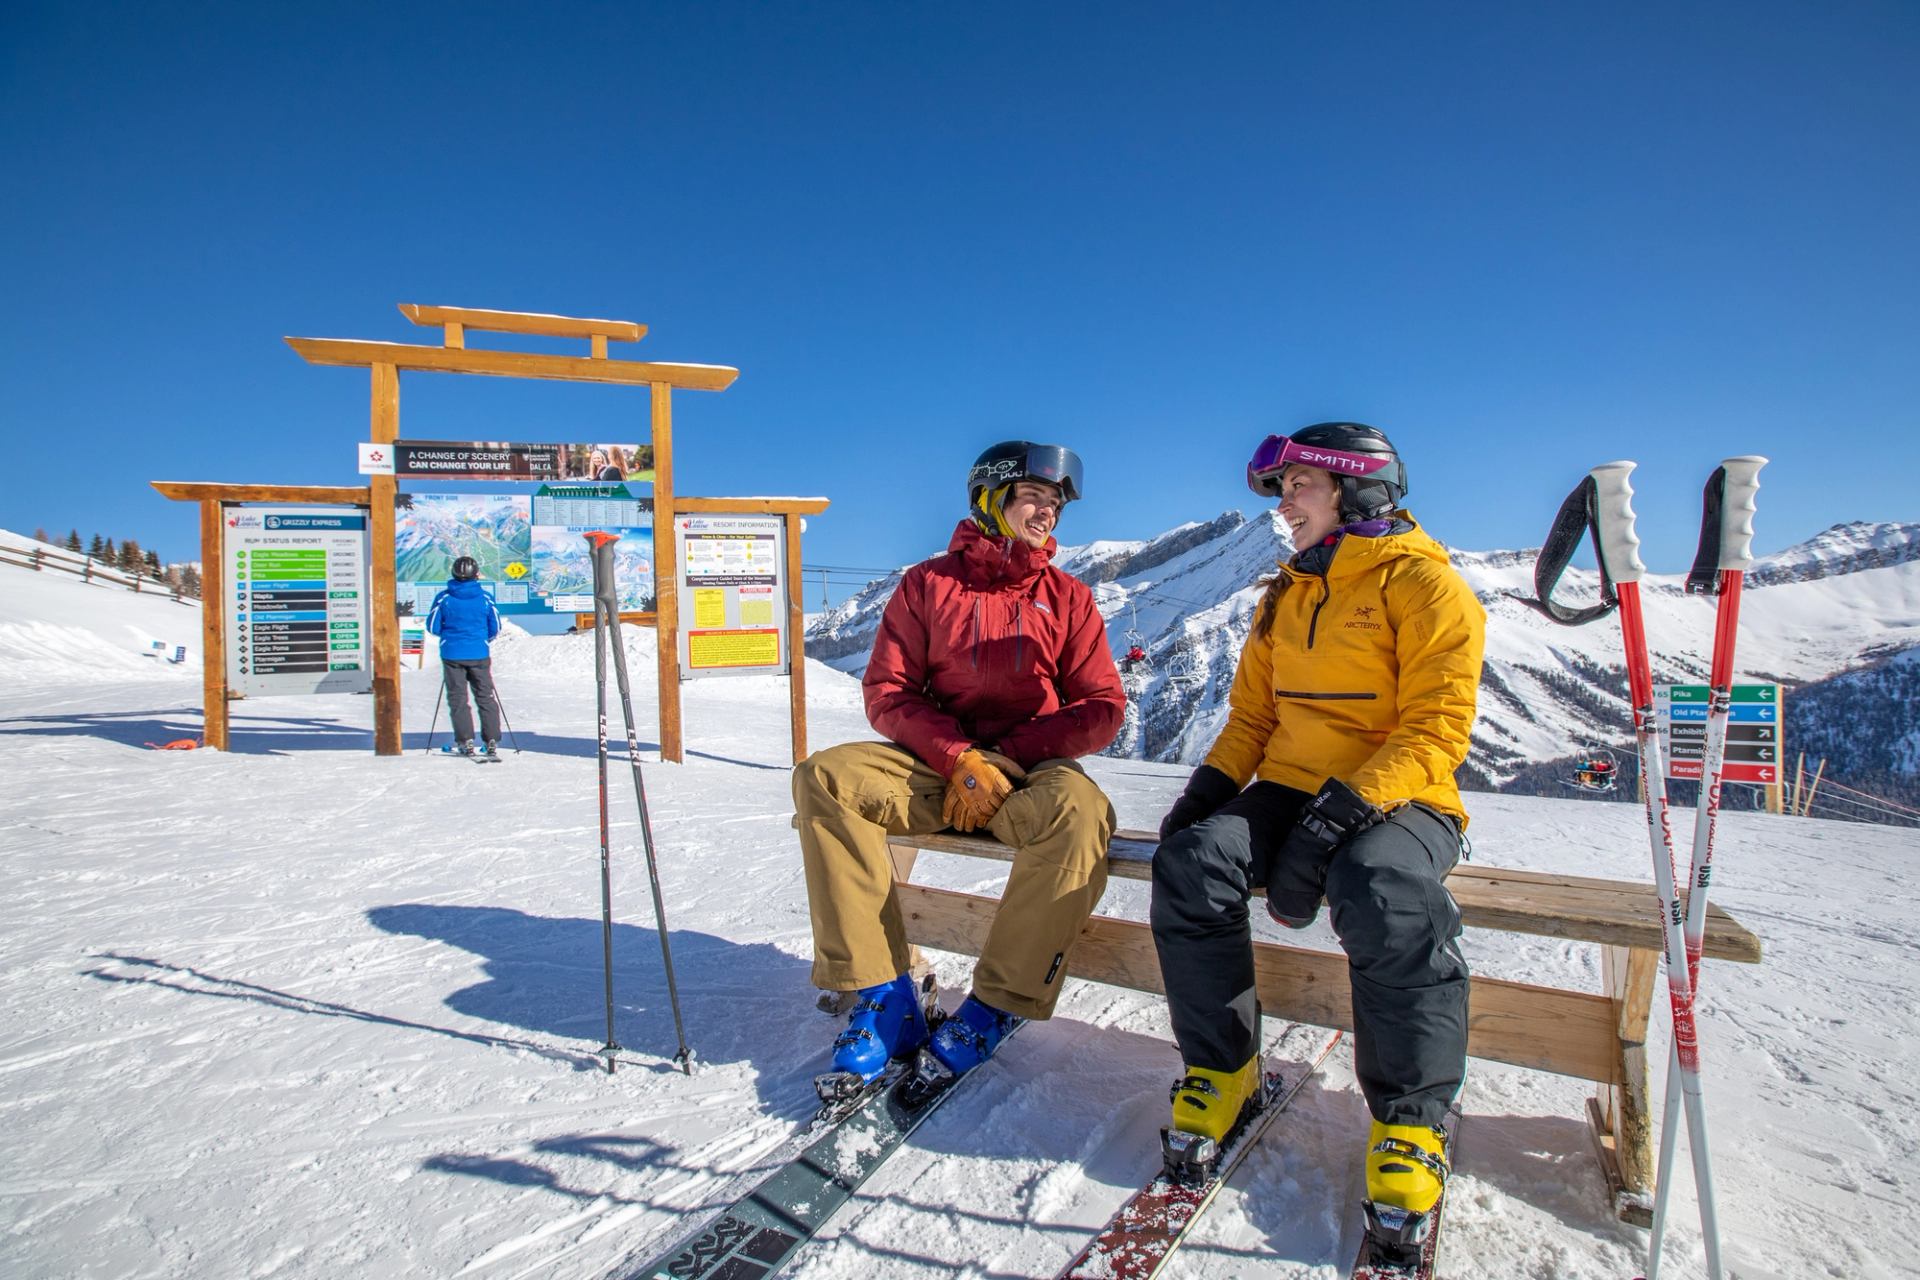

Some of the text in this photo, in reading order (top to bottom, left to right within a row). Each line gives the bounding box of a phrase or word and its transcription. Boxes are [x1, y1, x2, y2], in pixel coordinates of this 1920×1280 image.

[417, 452, 456, 460] CHANGE
[471, 452, 510, 460] SCENERY
[1299, 450, 1365, 472] SMITH
[430, 462, 467, 470] CHANGE
[468, 462, 492, 470] YOUR
[282, 518, 342, 526] GRIZZLY EXPRESS
[600, 714, 608, 753] LEKI
[626, 728, 640, 766] LEKI
[1673, 766, 1704, 774] Paradi
[1697, 865, 1712, 888] USA
